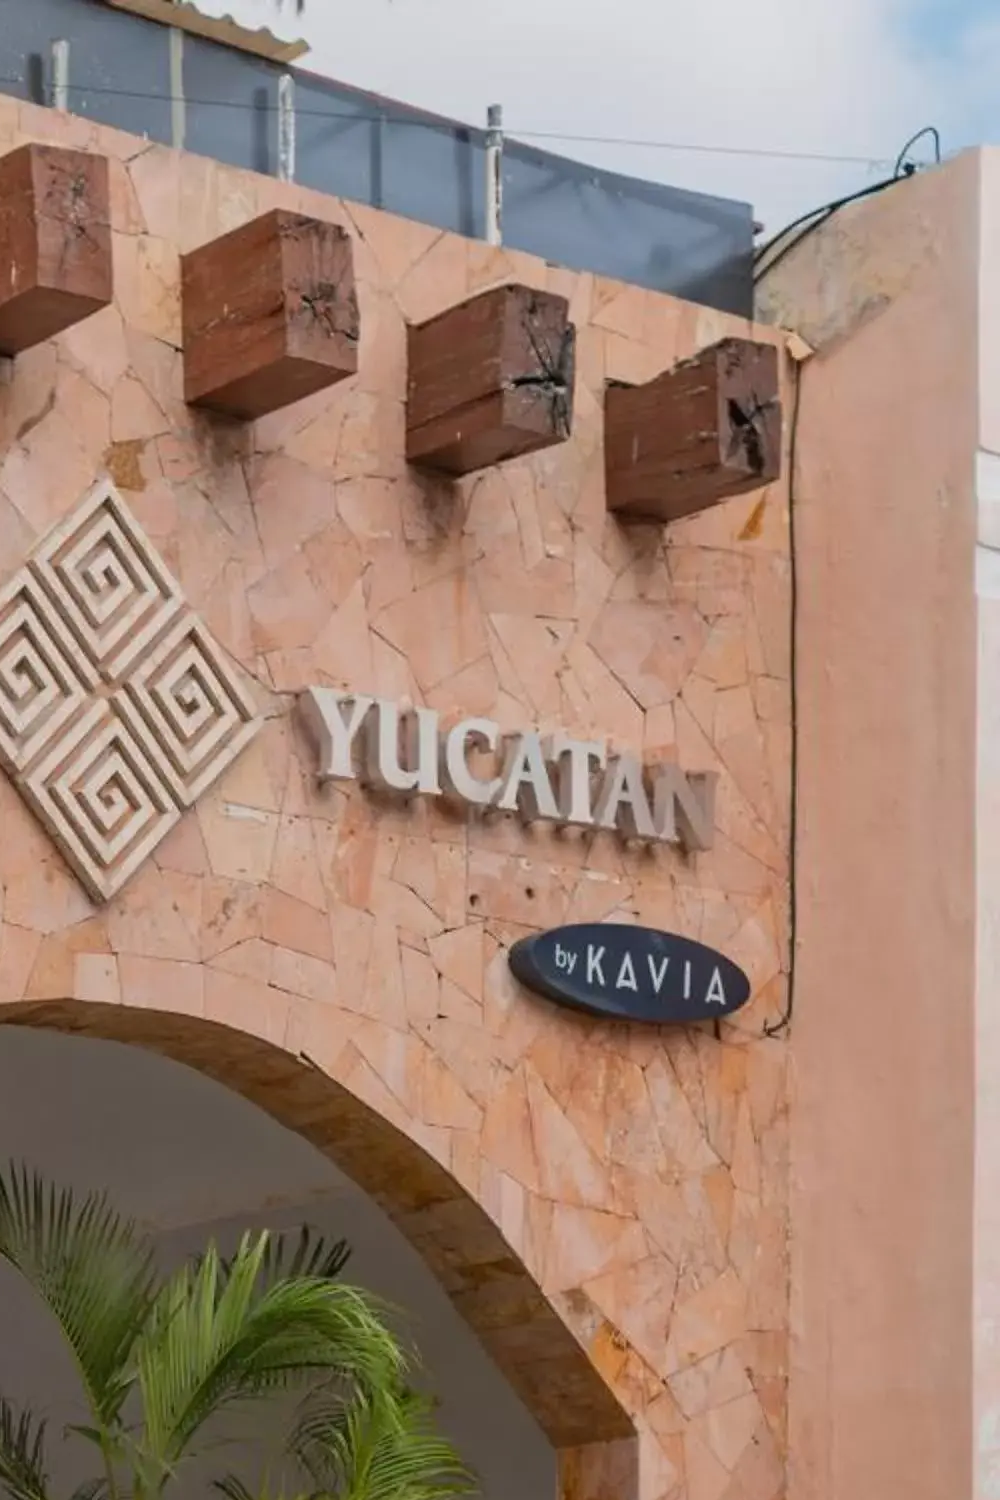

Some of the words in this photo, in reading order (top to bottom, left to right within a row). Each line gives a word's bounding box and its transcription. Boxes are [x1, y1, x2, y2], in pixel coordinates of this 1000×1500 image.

[310, 685, 717, 849] YUCATAN
[555, 944, 578, 974] by
[586, 944, 726, 1006] KAVIA
